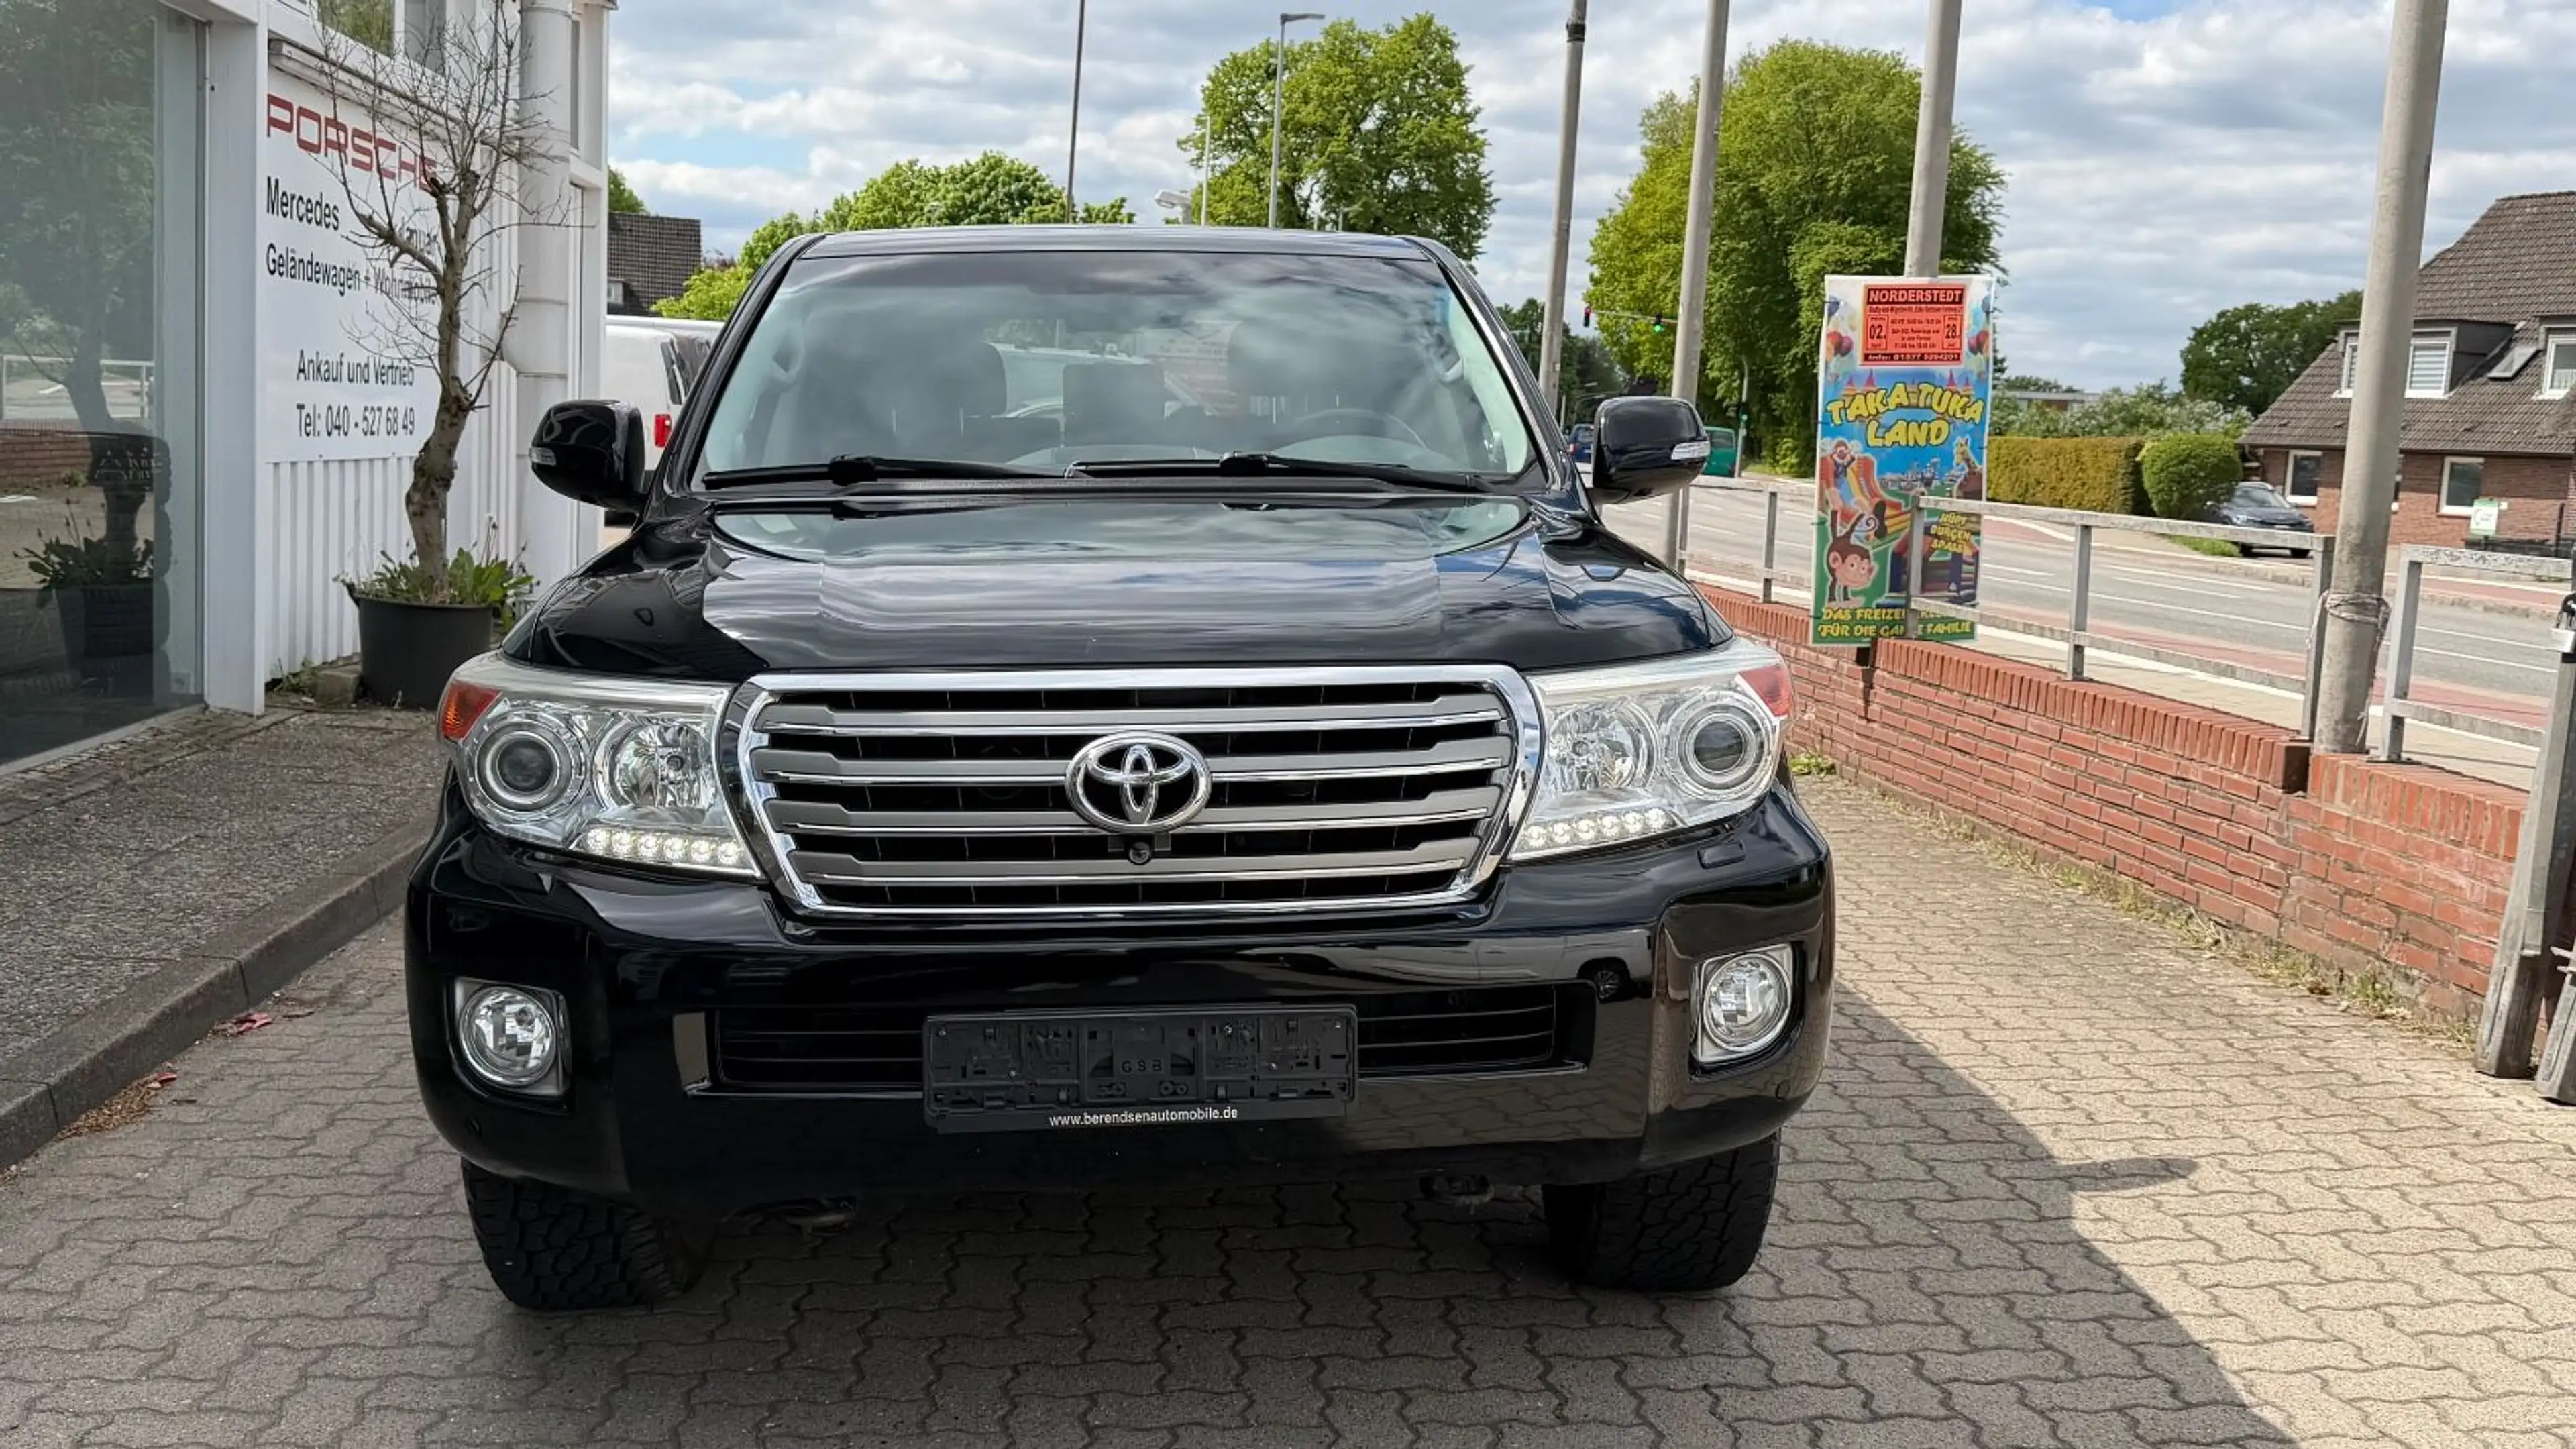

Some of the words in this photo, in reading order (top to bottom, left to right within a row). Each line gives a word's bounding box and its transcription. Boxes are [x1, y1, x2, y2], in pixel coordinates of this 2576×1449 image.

[267, 93, 437, 193] PORSCHE
[266, 176, 339, 231] Mercedes
[266, 243, 360, 297] Geländewagen
[1869, 290, 1962, 303] NORDERSTEDT
[296, 349, 344, 382] Ankauf
[347, 355, 370, 384] und
[374, 355, 415, 386] Vertrieb
[296, 402, 321, 437] Tel:
[326, 403, 350, 437] 040
[362, 405, 382, 437] 527
[386, 405, 398, 437] 68
[402, 405, 415, 437] 49
[1827, 382, 1909, 426] TAKA
[1917, 382, 1984, 425] TUKA
[1866, 419, 1950, 448] LAND
[1819, 622, 1850, 638] FÜR
[1854, 624, 1876, 637] DIE
[1927, 621, 1972, 634] FAMILIE
[1823, 607, 1852, 621] DAS
[1049, 1106, 1238, 1126] www.berendsenautomobile.de
